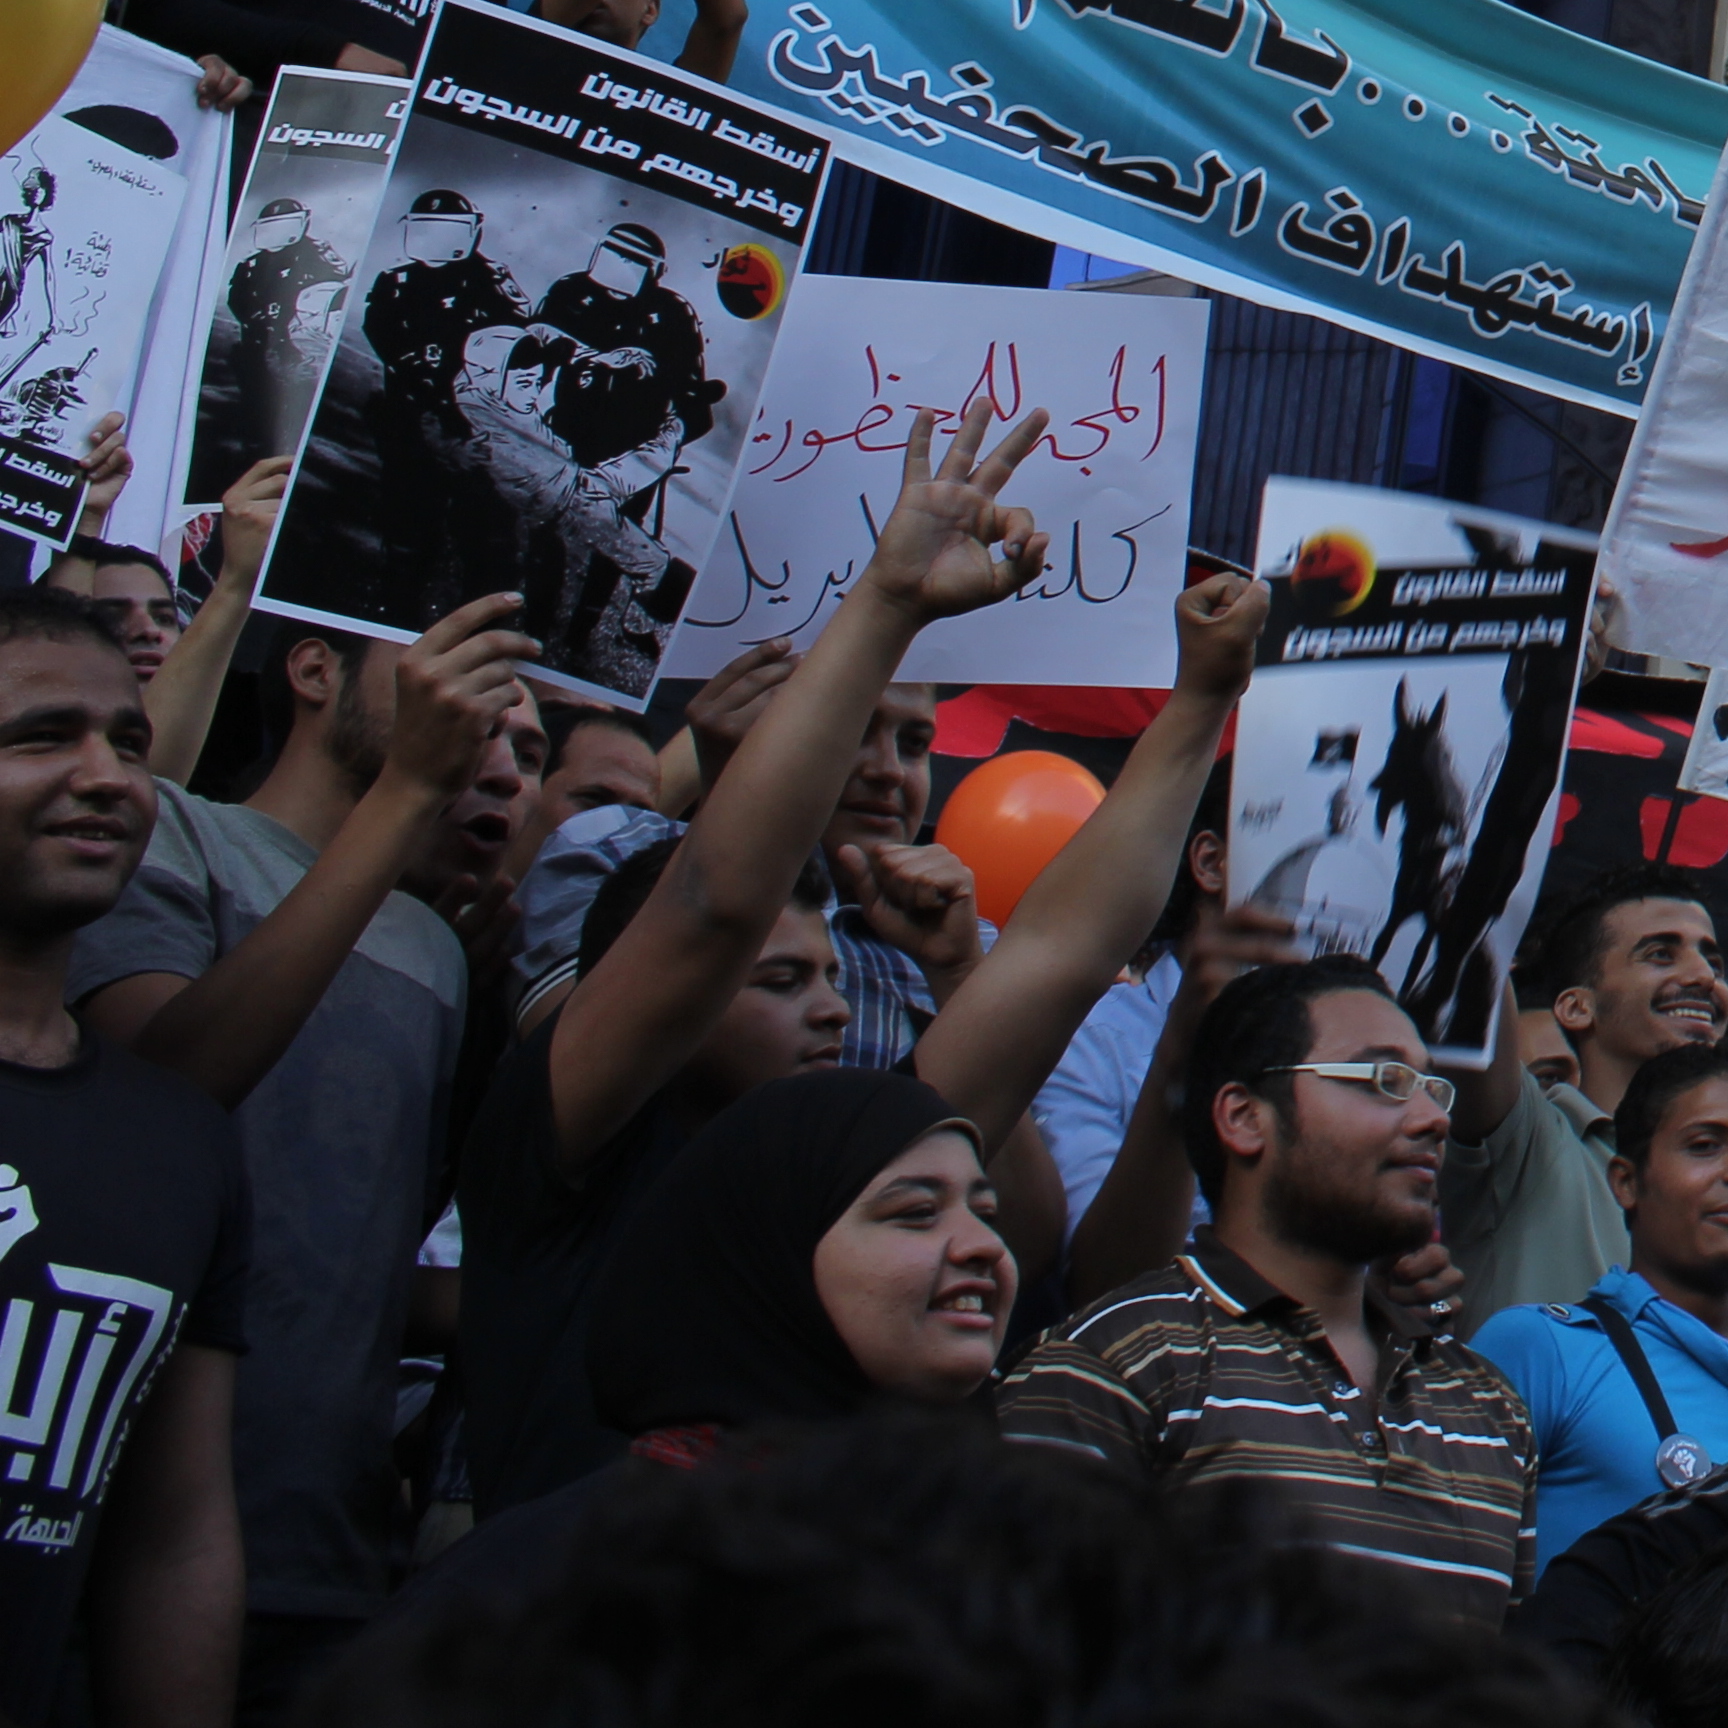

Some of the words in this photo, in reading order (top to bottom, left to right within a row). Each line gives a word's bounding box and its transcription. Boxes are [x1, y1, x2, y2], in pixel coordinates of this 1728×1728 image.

[421, 75, 582, 140] السجون
[578, 71, 713, 132] القانون
[766, 2, 1267, 239] الصحفيين
[267, 123, 387, 150] السجون
[578, 126, 641, 161] من
[711, 118, 821, 174] أسقط
[641, 148, 804, 228] وخرجهم
